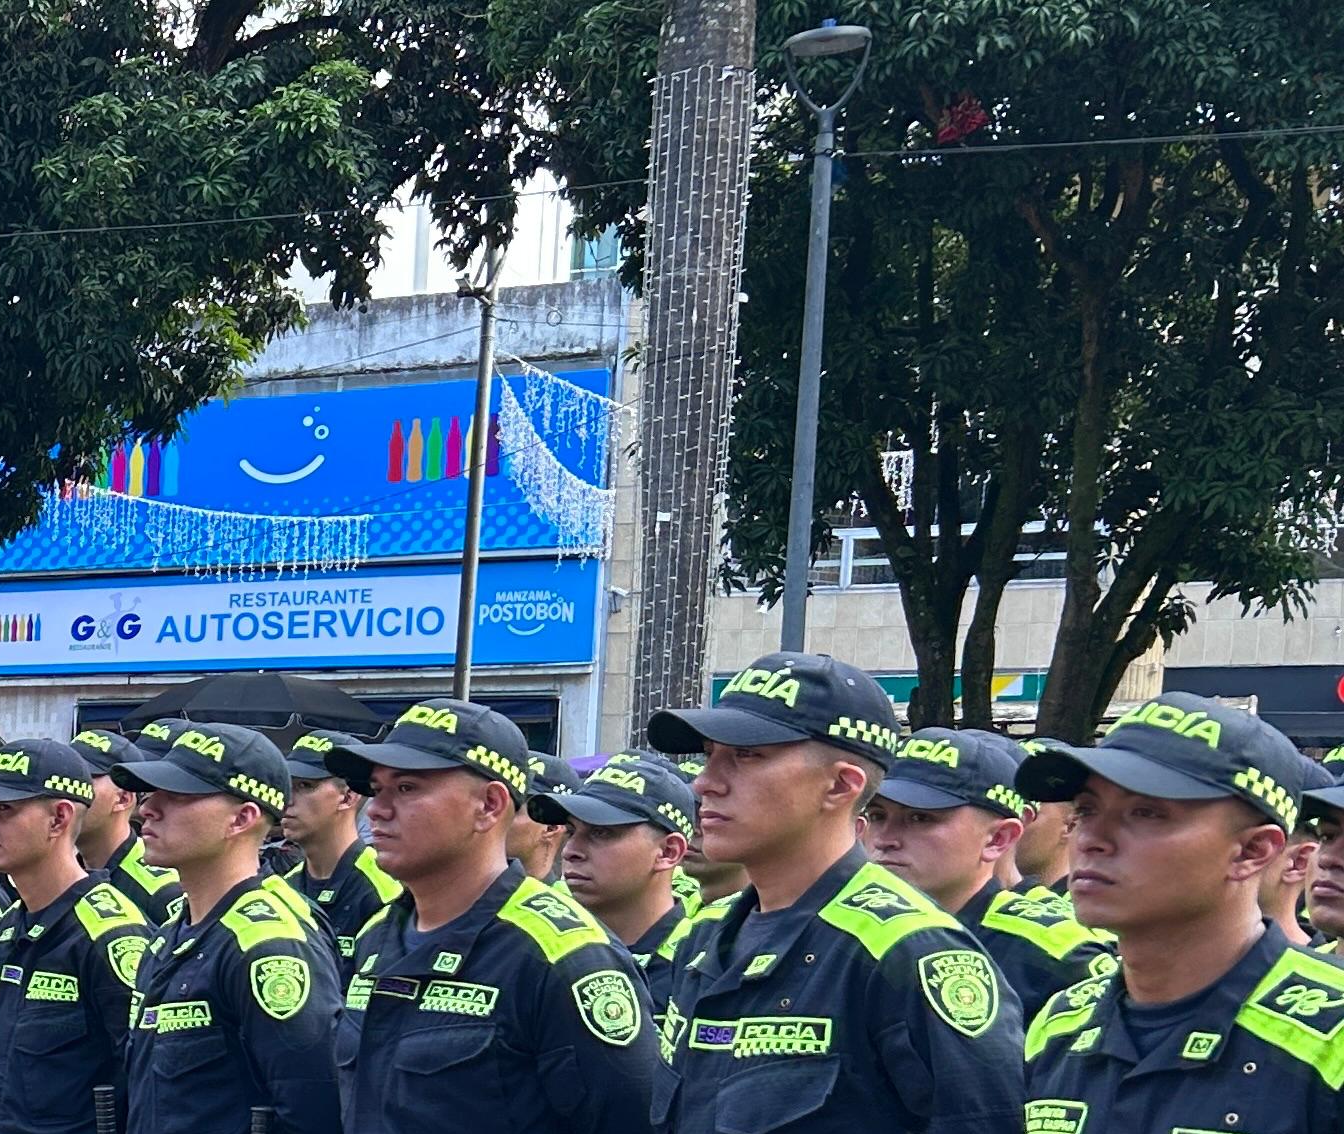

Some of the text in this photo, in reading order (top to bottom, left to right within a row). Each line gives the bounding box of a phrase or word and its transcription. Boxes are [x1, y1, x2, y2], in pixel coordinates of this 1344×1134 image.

[229, 588, 373, 607] RESTAURANTE
[495, 590, 551, 603] MANZANA
[156, 606, 445, 643] AUTOSERVICIO
[744, 1021, 817, 1041] POLICÍA
